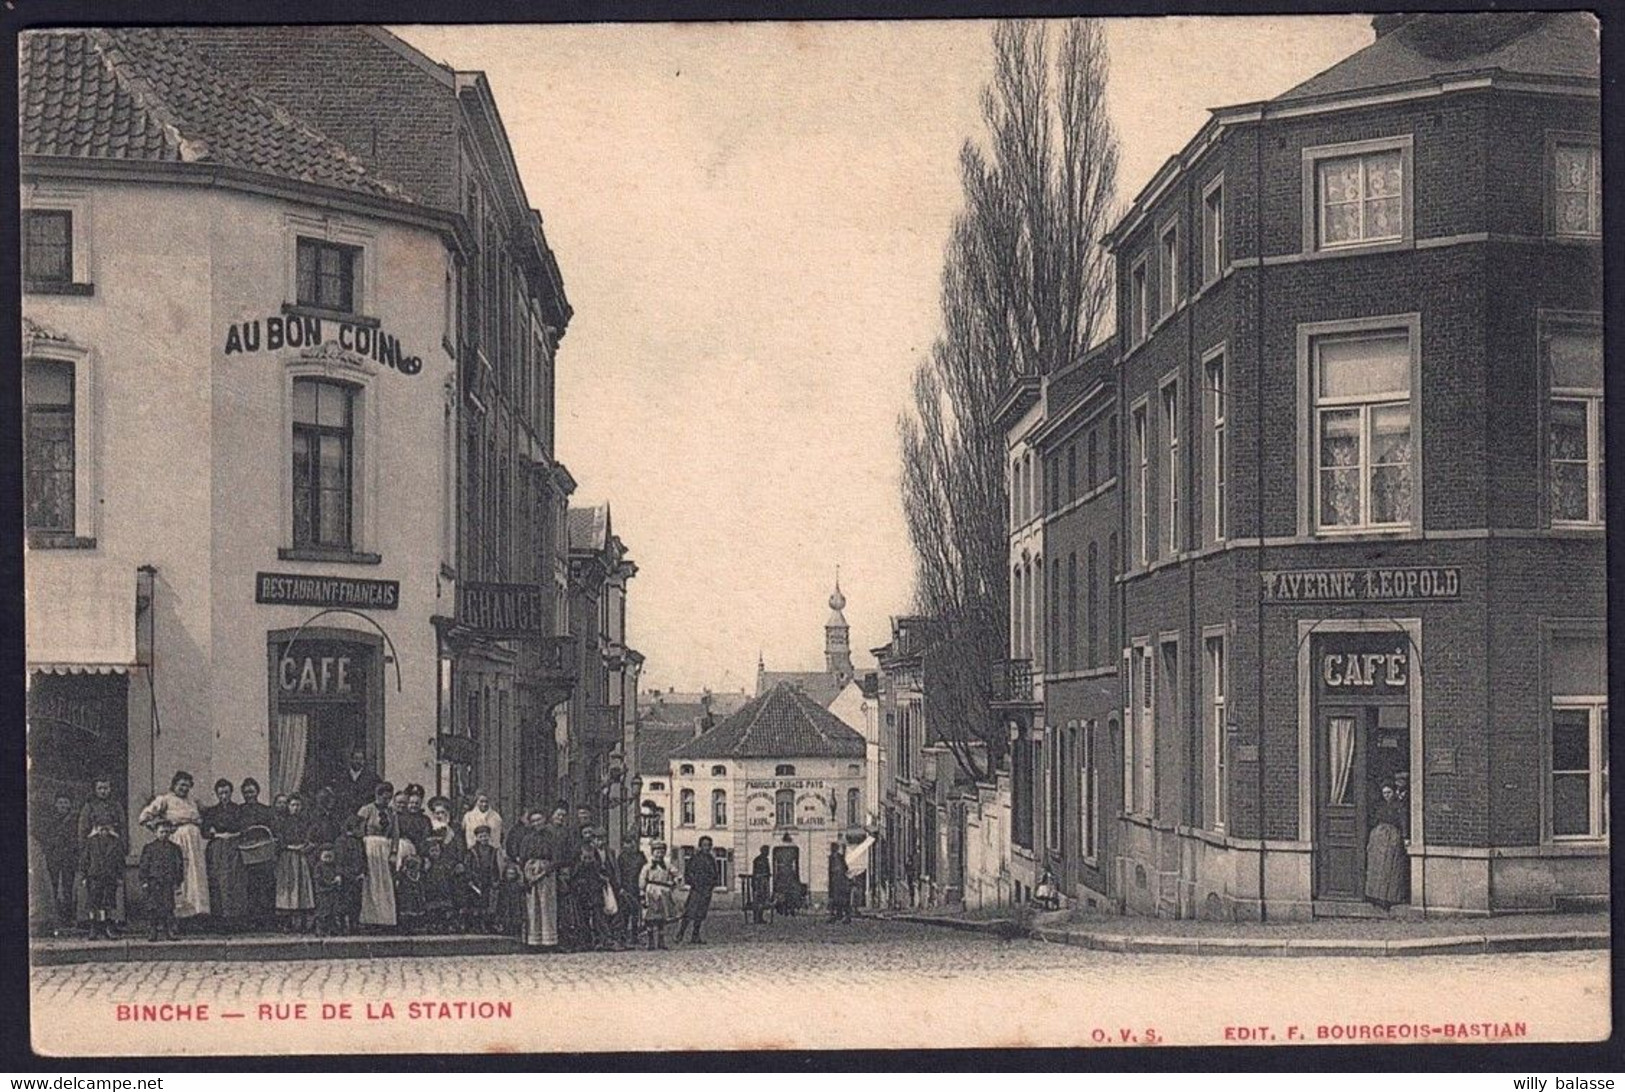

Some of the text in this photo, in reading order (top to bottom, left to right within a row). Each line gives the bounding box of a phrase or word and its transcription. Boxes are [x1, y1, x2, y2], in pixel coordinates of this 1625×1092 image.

[225, 315, 396, 370] AU BON COIN
[1260, 569, 1459, 599] TAVERNE LEOPOLD
[1324, 647, 1407, 687] CAFÉ
